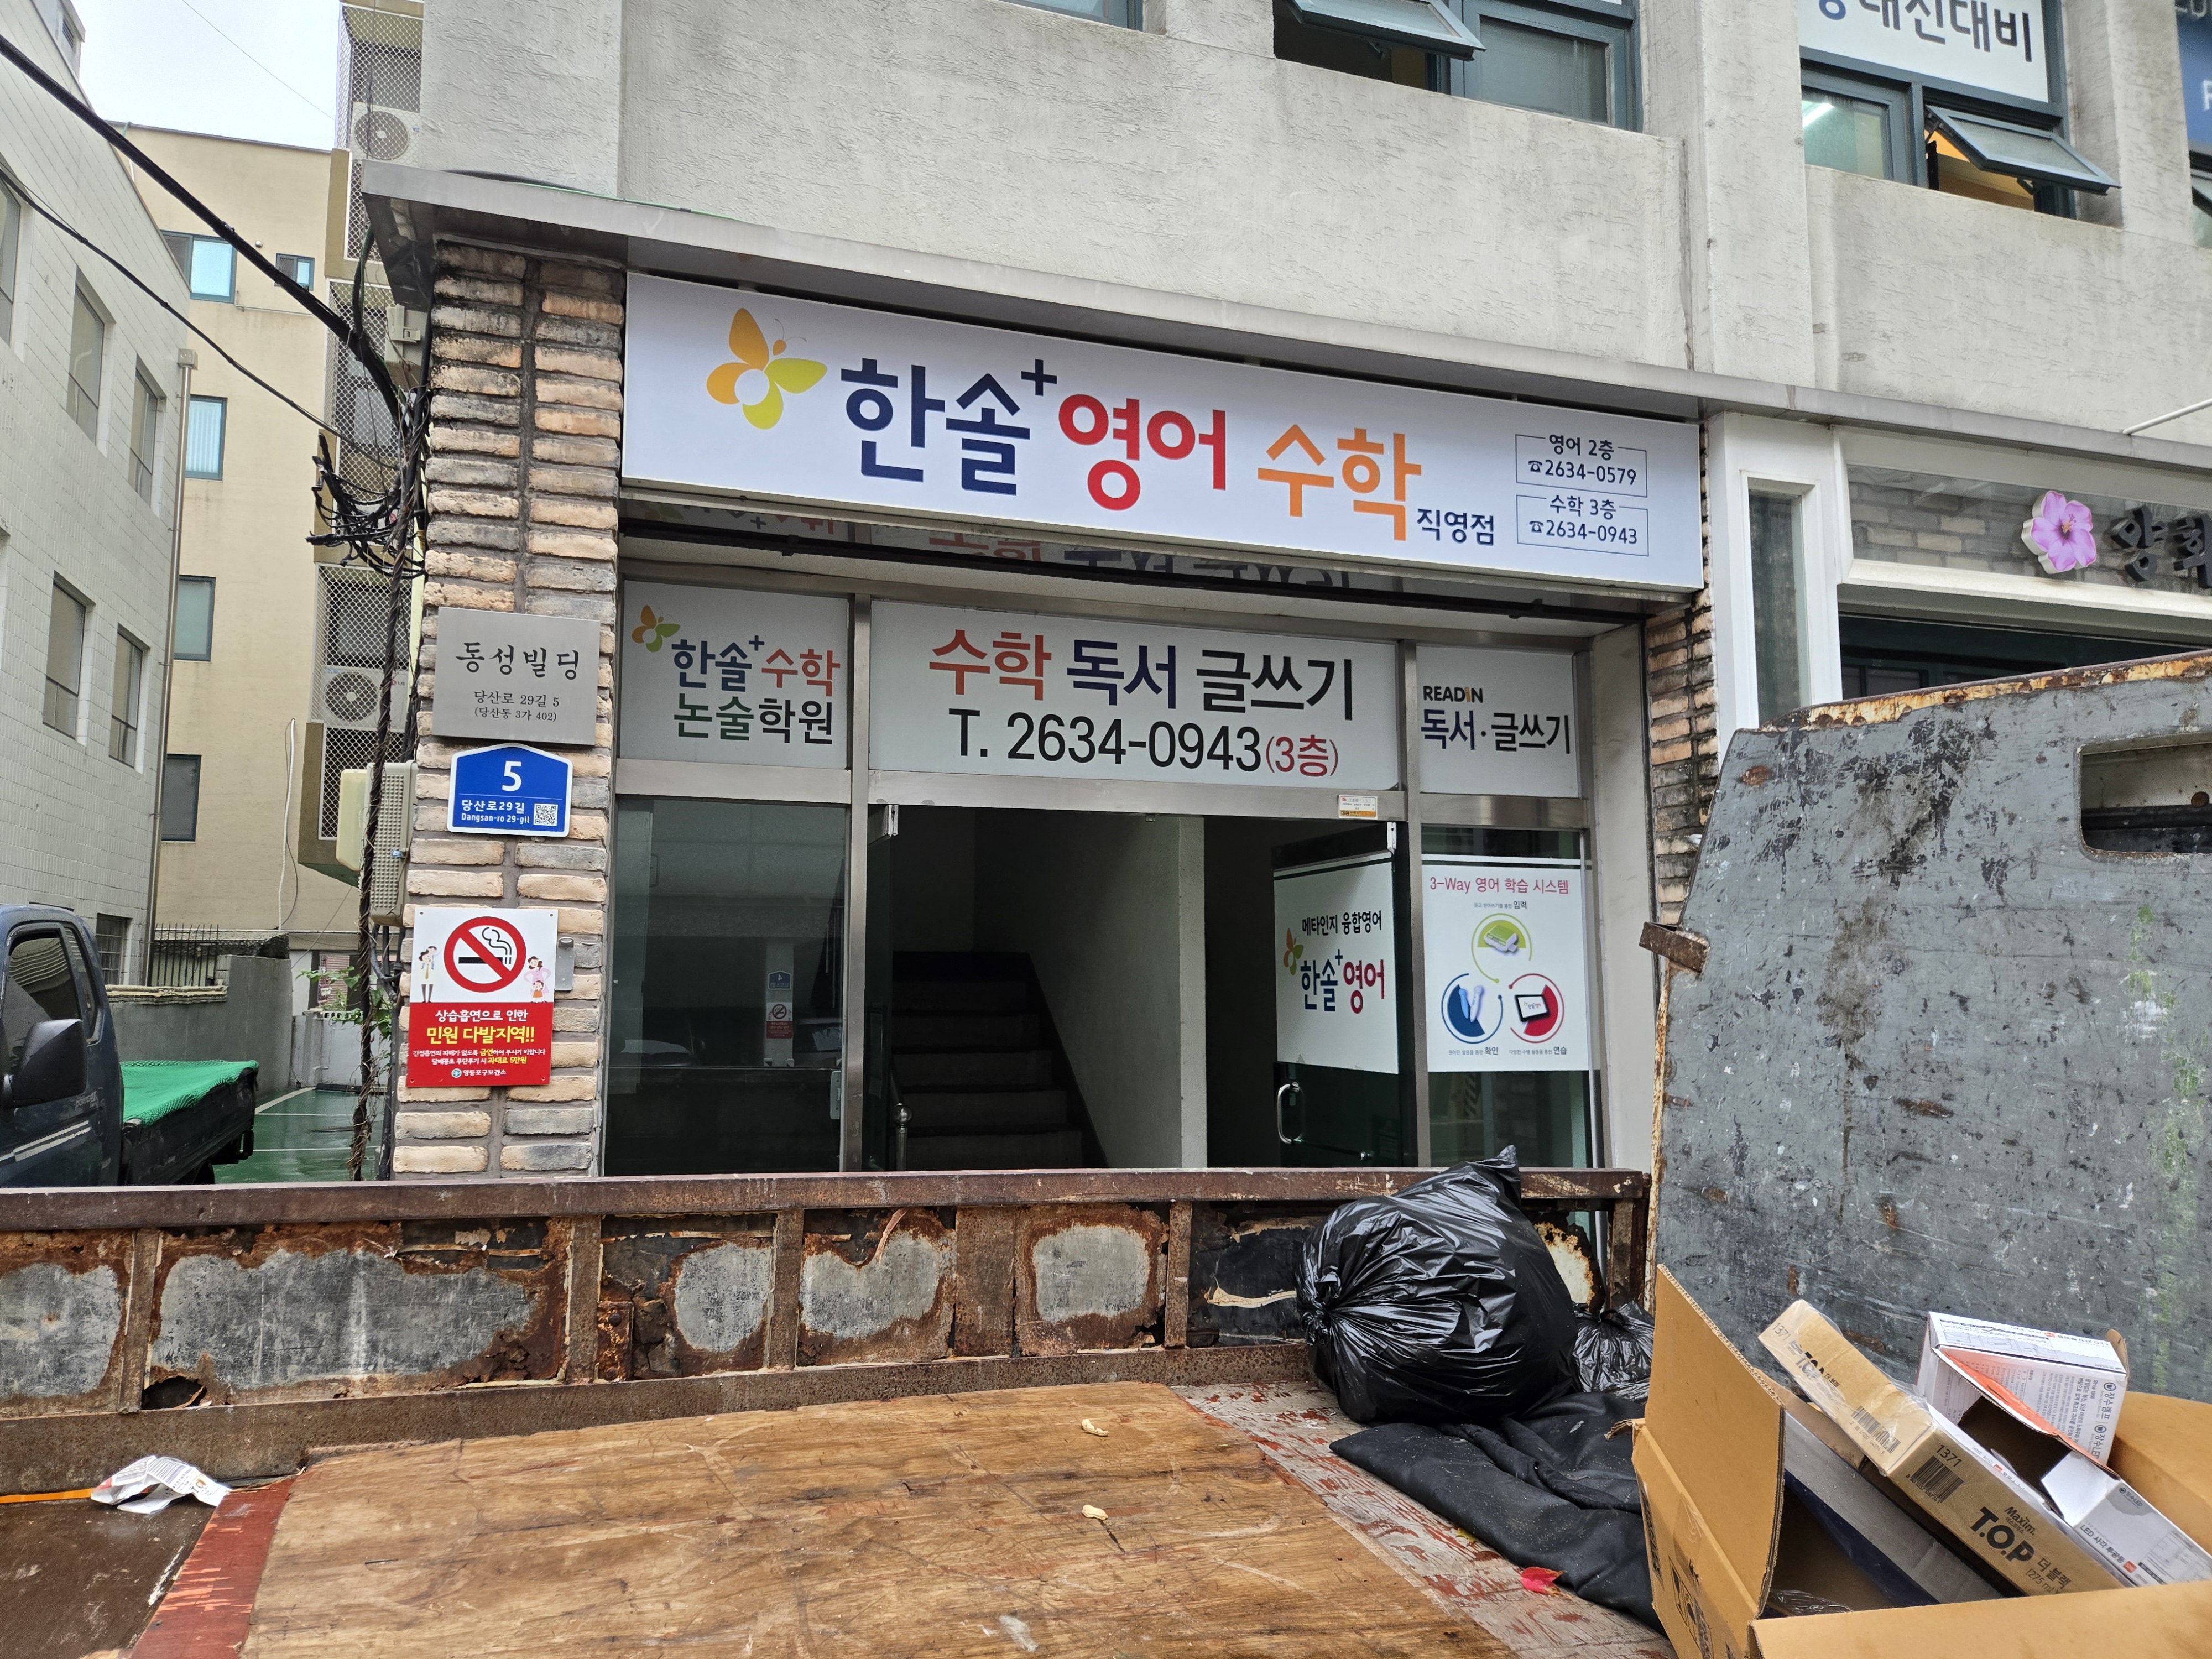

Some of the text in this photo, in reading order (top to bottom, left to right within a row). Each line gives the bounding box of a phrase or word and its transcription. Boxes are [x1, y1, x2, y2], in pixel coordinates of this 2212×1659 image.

[1549, 433, 1615, 461] 영어 2층
[1258, 423, 1422, 541] 수학
[1416, 508, 1495, 546] 직영점
[1549, 495, 1616, 520] 수학 3층
[456, 642, 580, 680] 동성빌딩
[929, 629, 1353, 721] 수학 독서 글쓰기
[474, 690, 560, 708] 당산로 29길 5
[474, 707, 556, 722] (당산동 3가 402)
[674, 693, 833, 745] 논술학원
[948, 708, 988, 758] T.
[502, 760, 522, 791] 5
[461, 813, 530, 825] Dangsan-ro 29-gil
[1430, 877, 1569, 894] 3-Way 영어 학습 시스템
[1514, 901, 1527, 910] 입력
[1302, 910, 1382, 936] 메타인지 융합영어
[435, 1009, 528, 1022] 상습흡연으로 인한
[426, 1026, 535, 1044] 민원 다발지역!!
[1484, 1046, 1498, 1056] 확인
[1553, 1046, 1567, 1055] 연습
[1936, 1444, 1963, 1467] 1371
[1970, 1506, 2072, 1589] T.O.P 더 블랙
[2080, 1525, 2094, 1537] LED
[2093, 1536, 2107, 1548] 사각
